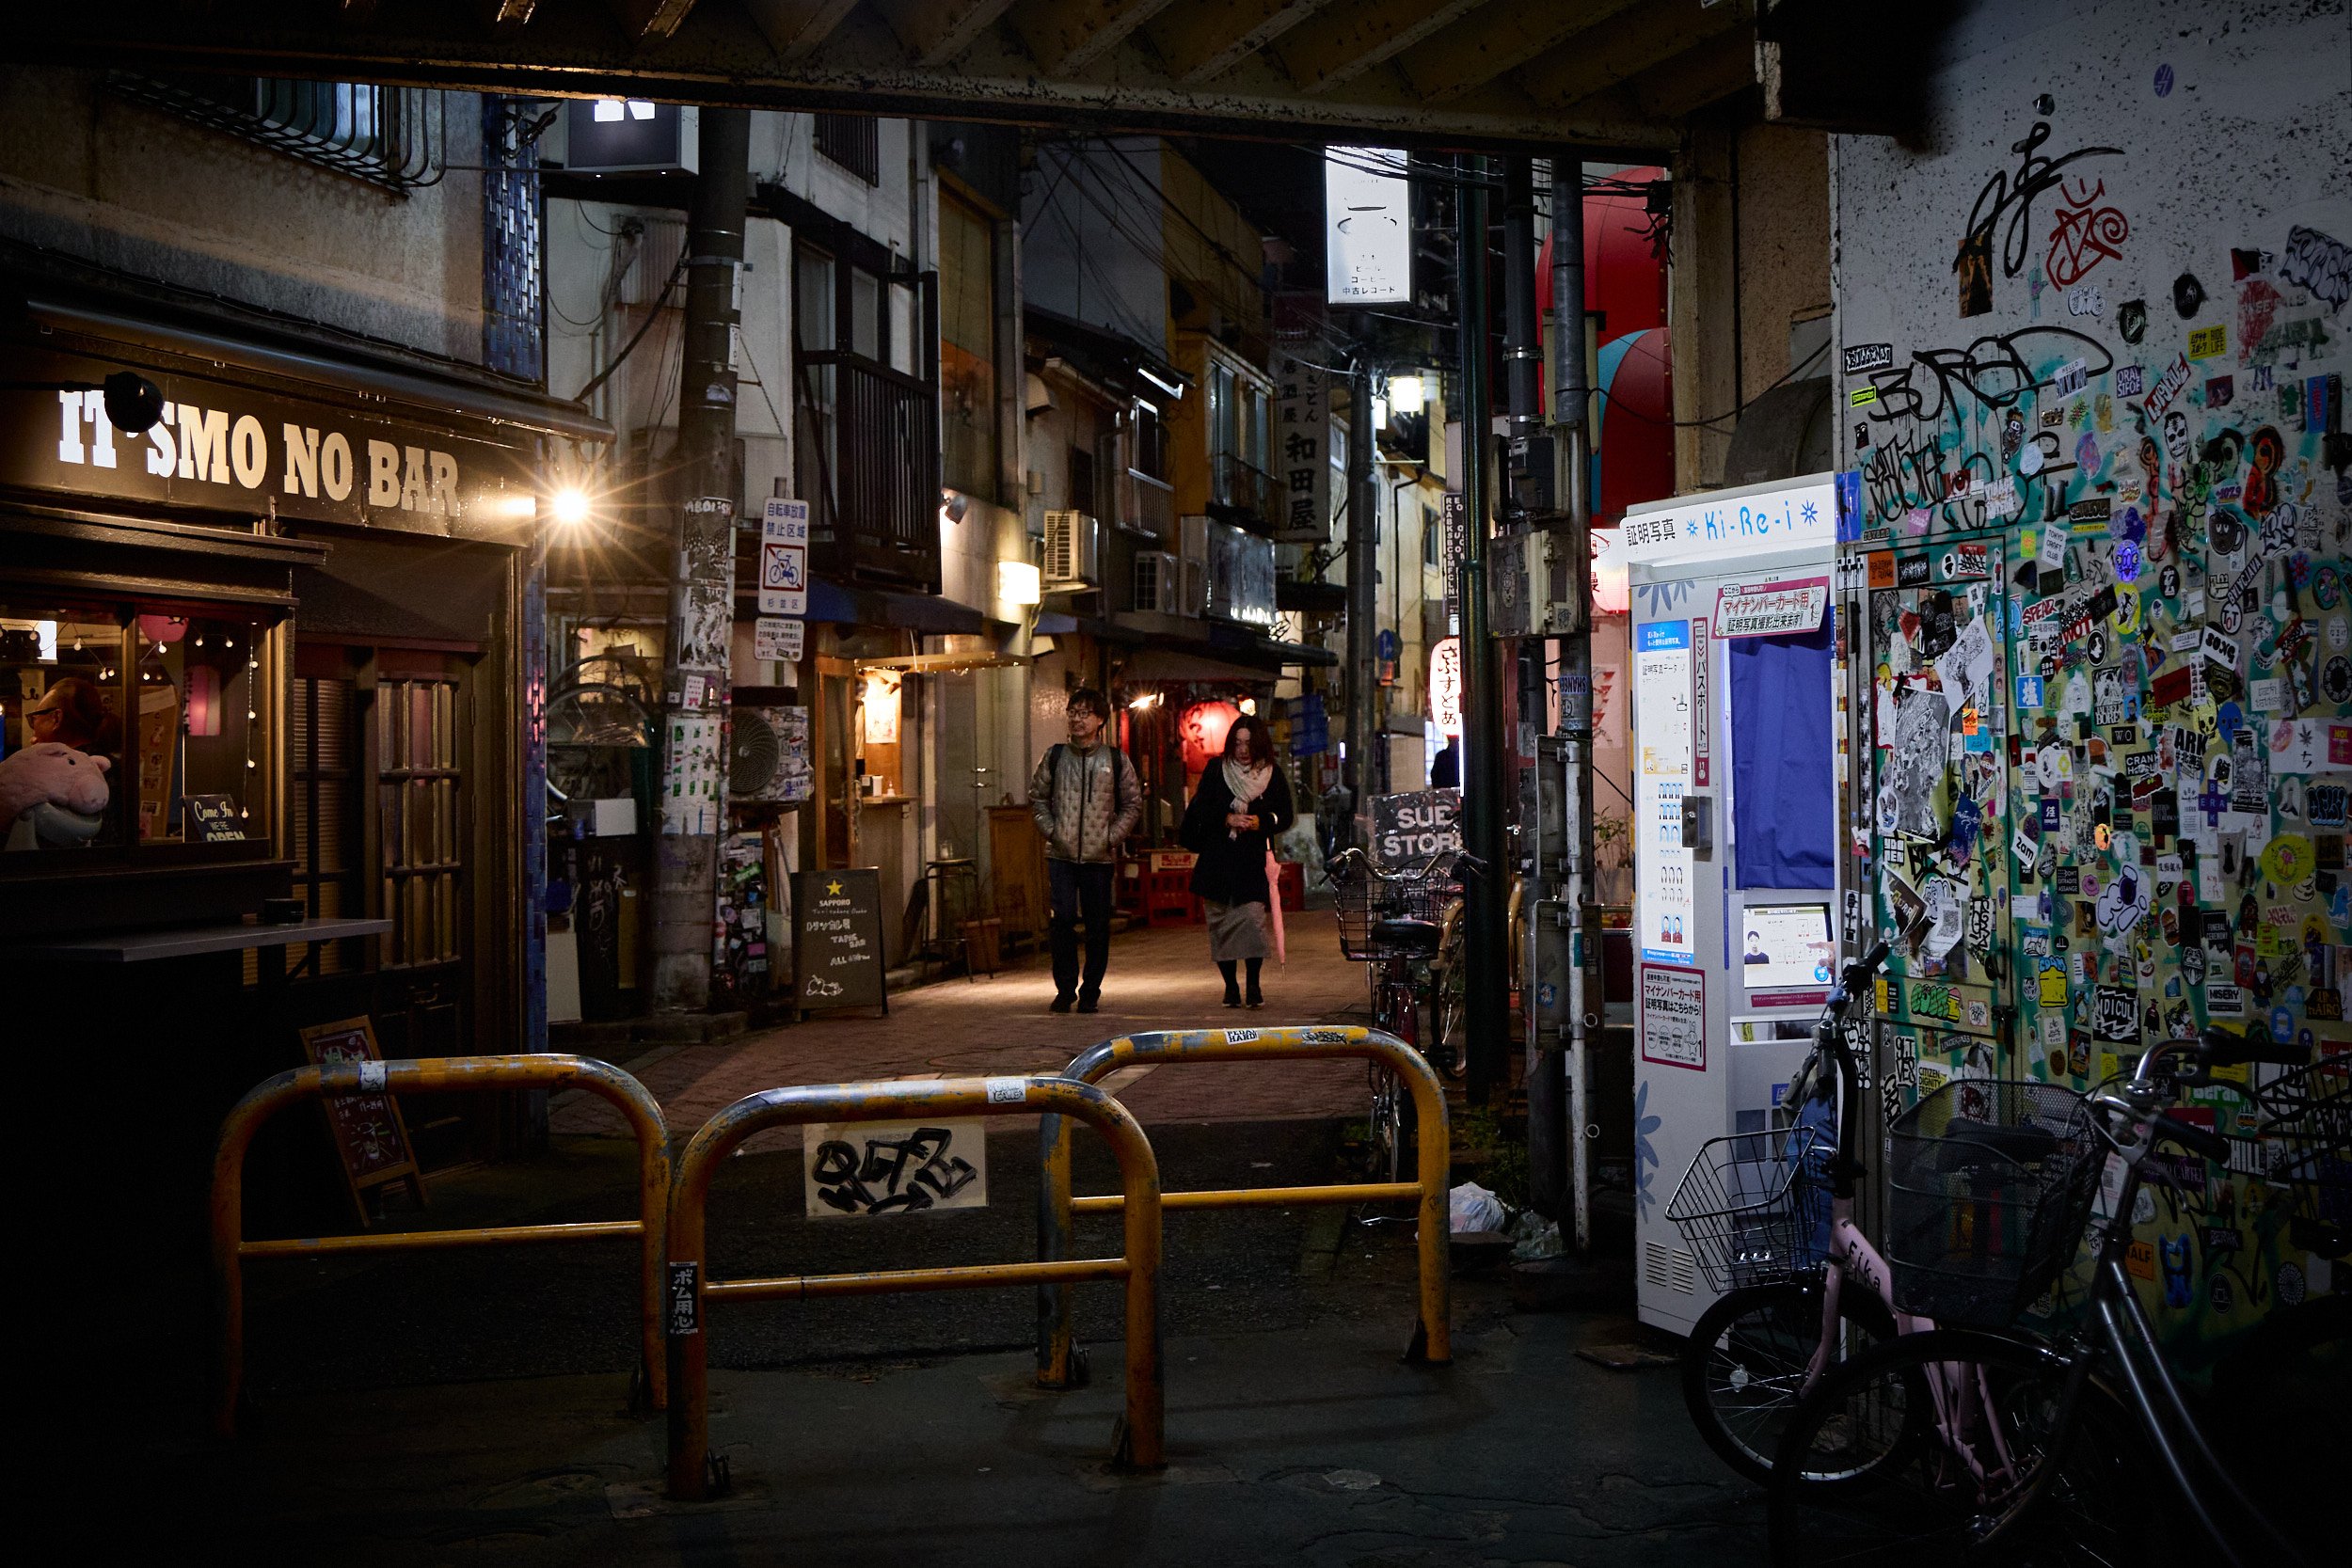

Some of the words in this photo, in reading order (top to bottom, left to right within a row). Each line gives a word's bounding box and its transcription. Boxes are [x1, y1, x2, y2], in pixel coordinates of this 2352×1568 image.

[283, 422, 354, 501] NO
[368, 437, 460, 517] BAR
[1285, 432, 1316, 531] 和田屋
[767, 502, 806, 520] 自転車放置
[766, 521, 806, 539] 禁止区域
[1627, 517, 1676, 546] 証明写真
[1724, 591, 1808, 616] マイナンバーカード用
[194, 800, 219, 822] Come
[220, 801, 234, 818] In
[818, 898, 851, 908] SAPPORO
[1645, 985, 1701, 1004] マイナンバーカード用
[1228, 1035, 1258, 1043] HARD
[1918, 1067, 1941, 1080] CITIZEN
[1918, 1076, 1942, 1089] DIGNITY
[1848, 1240, 1881, 1295] Fika
[674, 1268, 694, 1330] ボム用心
